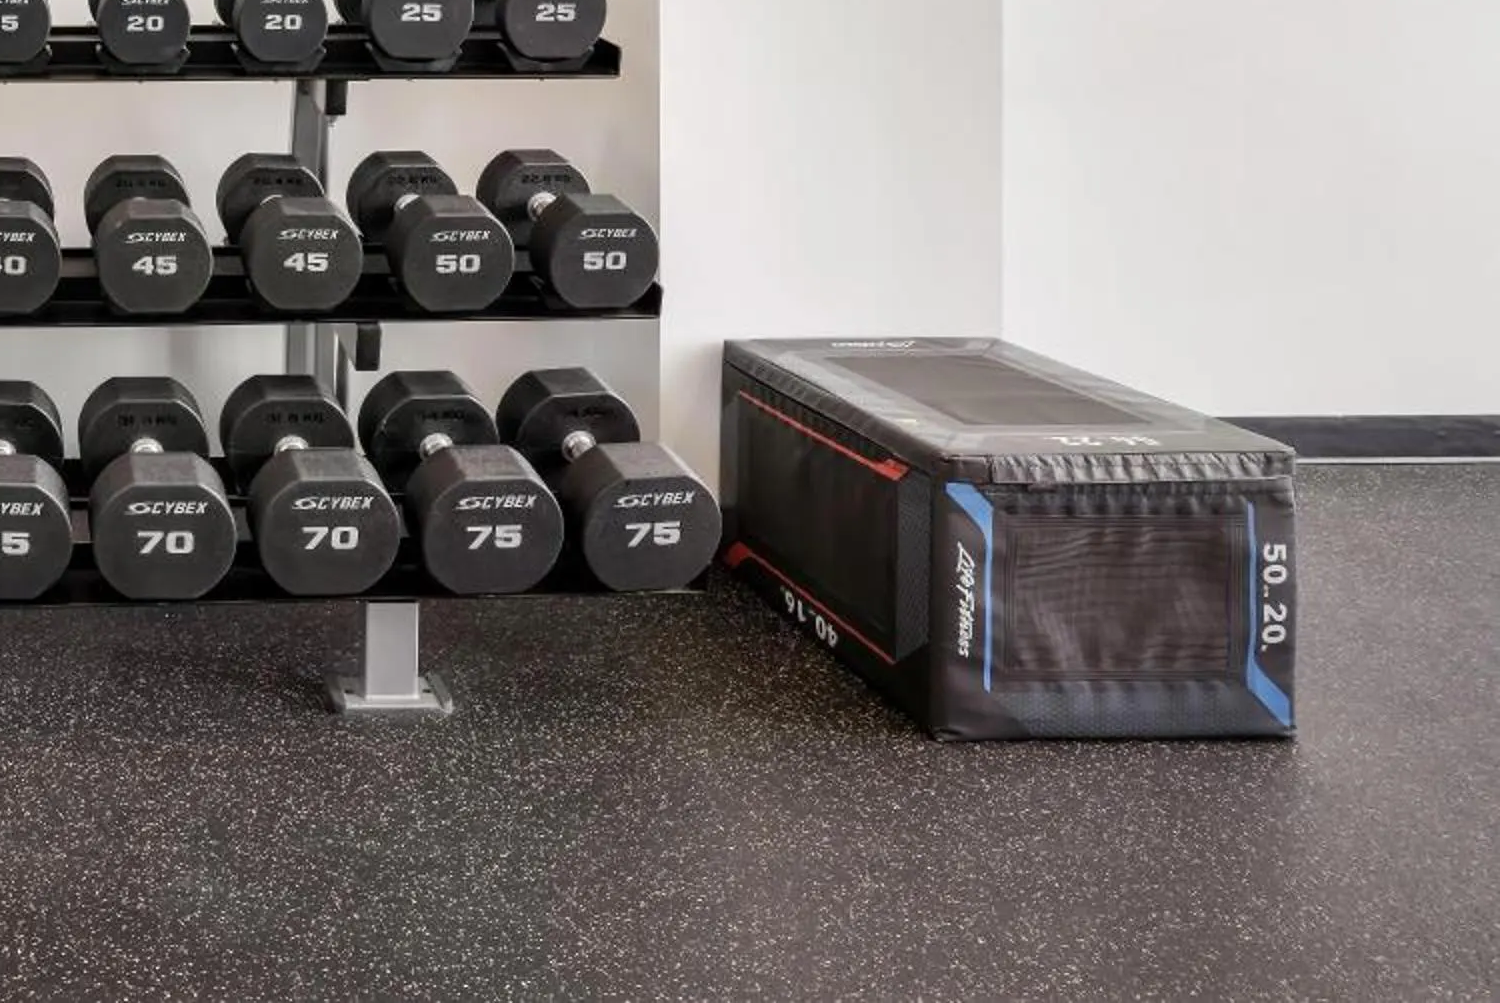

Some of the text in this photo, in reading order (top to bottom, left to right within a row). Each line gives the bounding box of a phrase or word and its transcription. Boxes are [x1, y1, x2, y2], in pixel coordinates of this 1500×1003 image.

[401, 3, 442, 22] 25
[535, 3, 576, 22] 25
[126, 15, 164, 32] 20
[264, 14, 302, 30] 20
[145, 232, 187, 244] CYBEX
[298, 228, 339, 240] CYBEX
[450, 230, 491, 242] CYBEX
[597, 228, 637, 240] CYBEX
[132, 255, 177, 275] 45
[284, 252, 329, 272] 45
[435, 254, 481, 274] 50
[583, 251, 627, 270] 50
[153, 501, 208, 515] CYBEX
[319, 496, 374, 510] CYBEX
[482, 494, 537, 510] CYBEX
[642, 491, 695, 508] CYBEX
[137, 531, 194, 554] 70
[302, 526, 359, 550] 70
[466, 524, 522, 550] 75
[625, 520, 681, 547] 75
